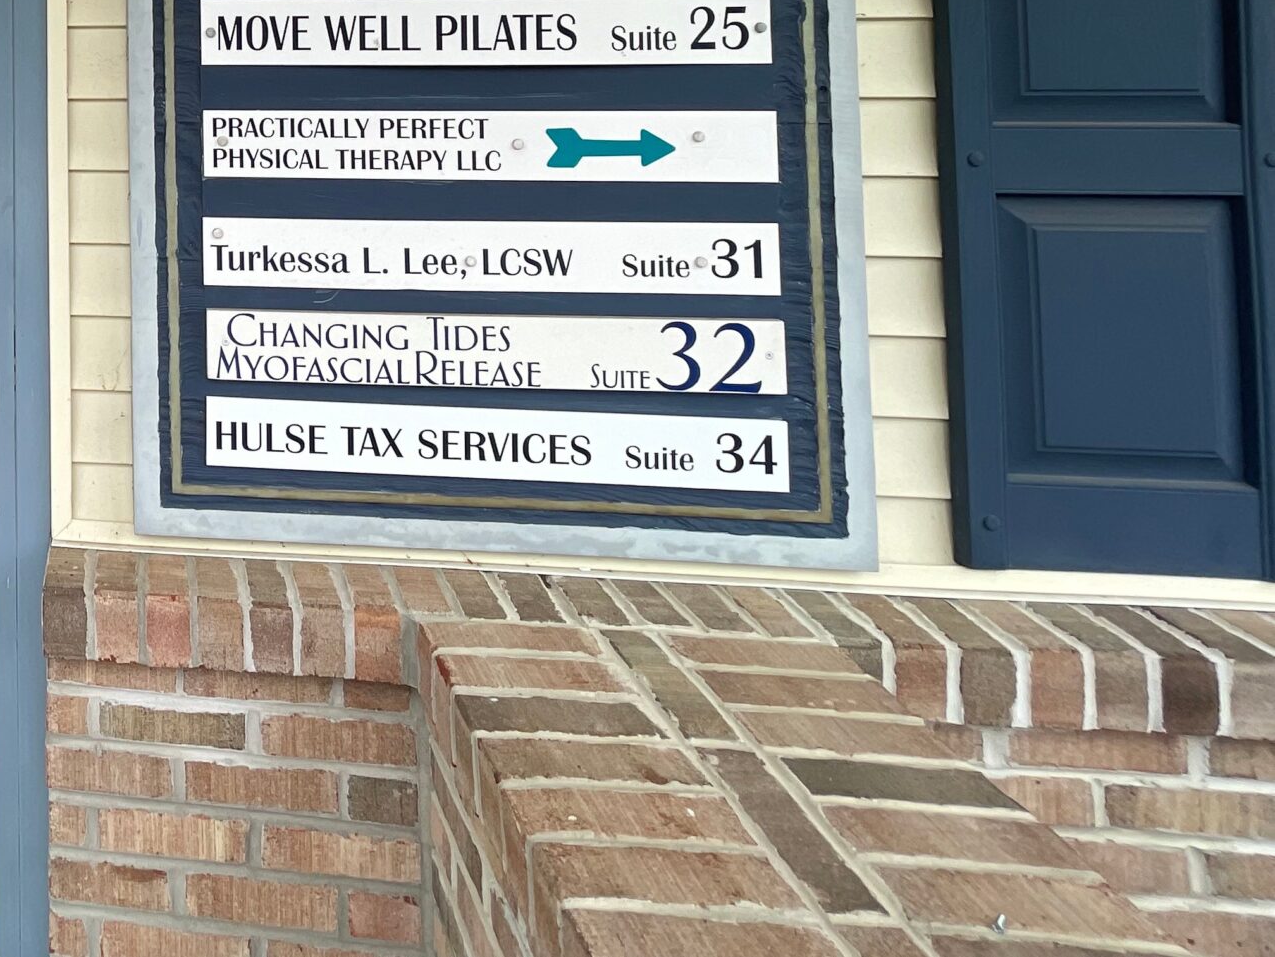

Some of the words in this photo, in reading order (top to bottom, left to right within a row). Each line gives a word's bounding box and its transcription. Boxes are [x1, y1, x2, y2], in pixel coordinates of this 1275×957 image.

[217, 15, 311, 51] MOVE
[325, 15, 421, 51] WELL
[436, 13, 578, 51] PILATES
[611, 25, 677, 51] Suite
[689, 6, 750, 50] 25
[212, 117, 369, 139] PRACTICALLY
[379, 118, 489, 140] PERFECT
[212, 148, 328, 169] PHYSICAL
[336, 149, 447, 170] THERAPY
[457, 150, 502, 172] LLC
[211, 244, 349, 273] Turkessa
[363, 249, 389, 274] L.
[404, 249, 467, 280] Lee,
[482, 249, 573, 277] LCSW
[622, 254, 690, 277] Suite
[711, 239, 764, 279] 31
[226, 313, 409, 349] CHANGING
[425, 316, 512, 352] TIDES
[590, 363, 651, 389] SUITE
[656, 321, 762, 393] 32
[215, 421, 328, 455] HULSE
[340, 426, 403, 458] TAX
[418, 429, 592, 465] SERVICES
[625, 445, 694, 471] Suite
[715, 432, 778, 475] 34
